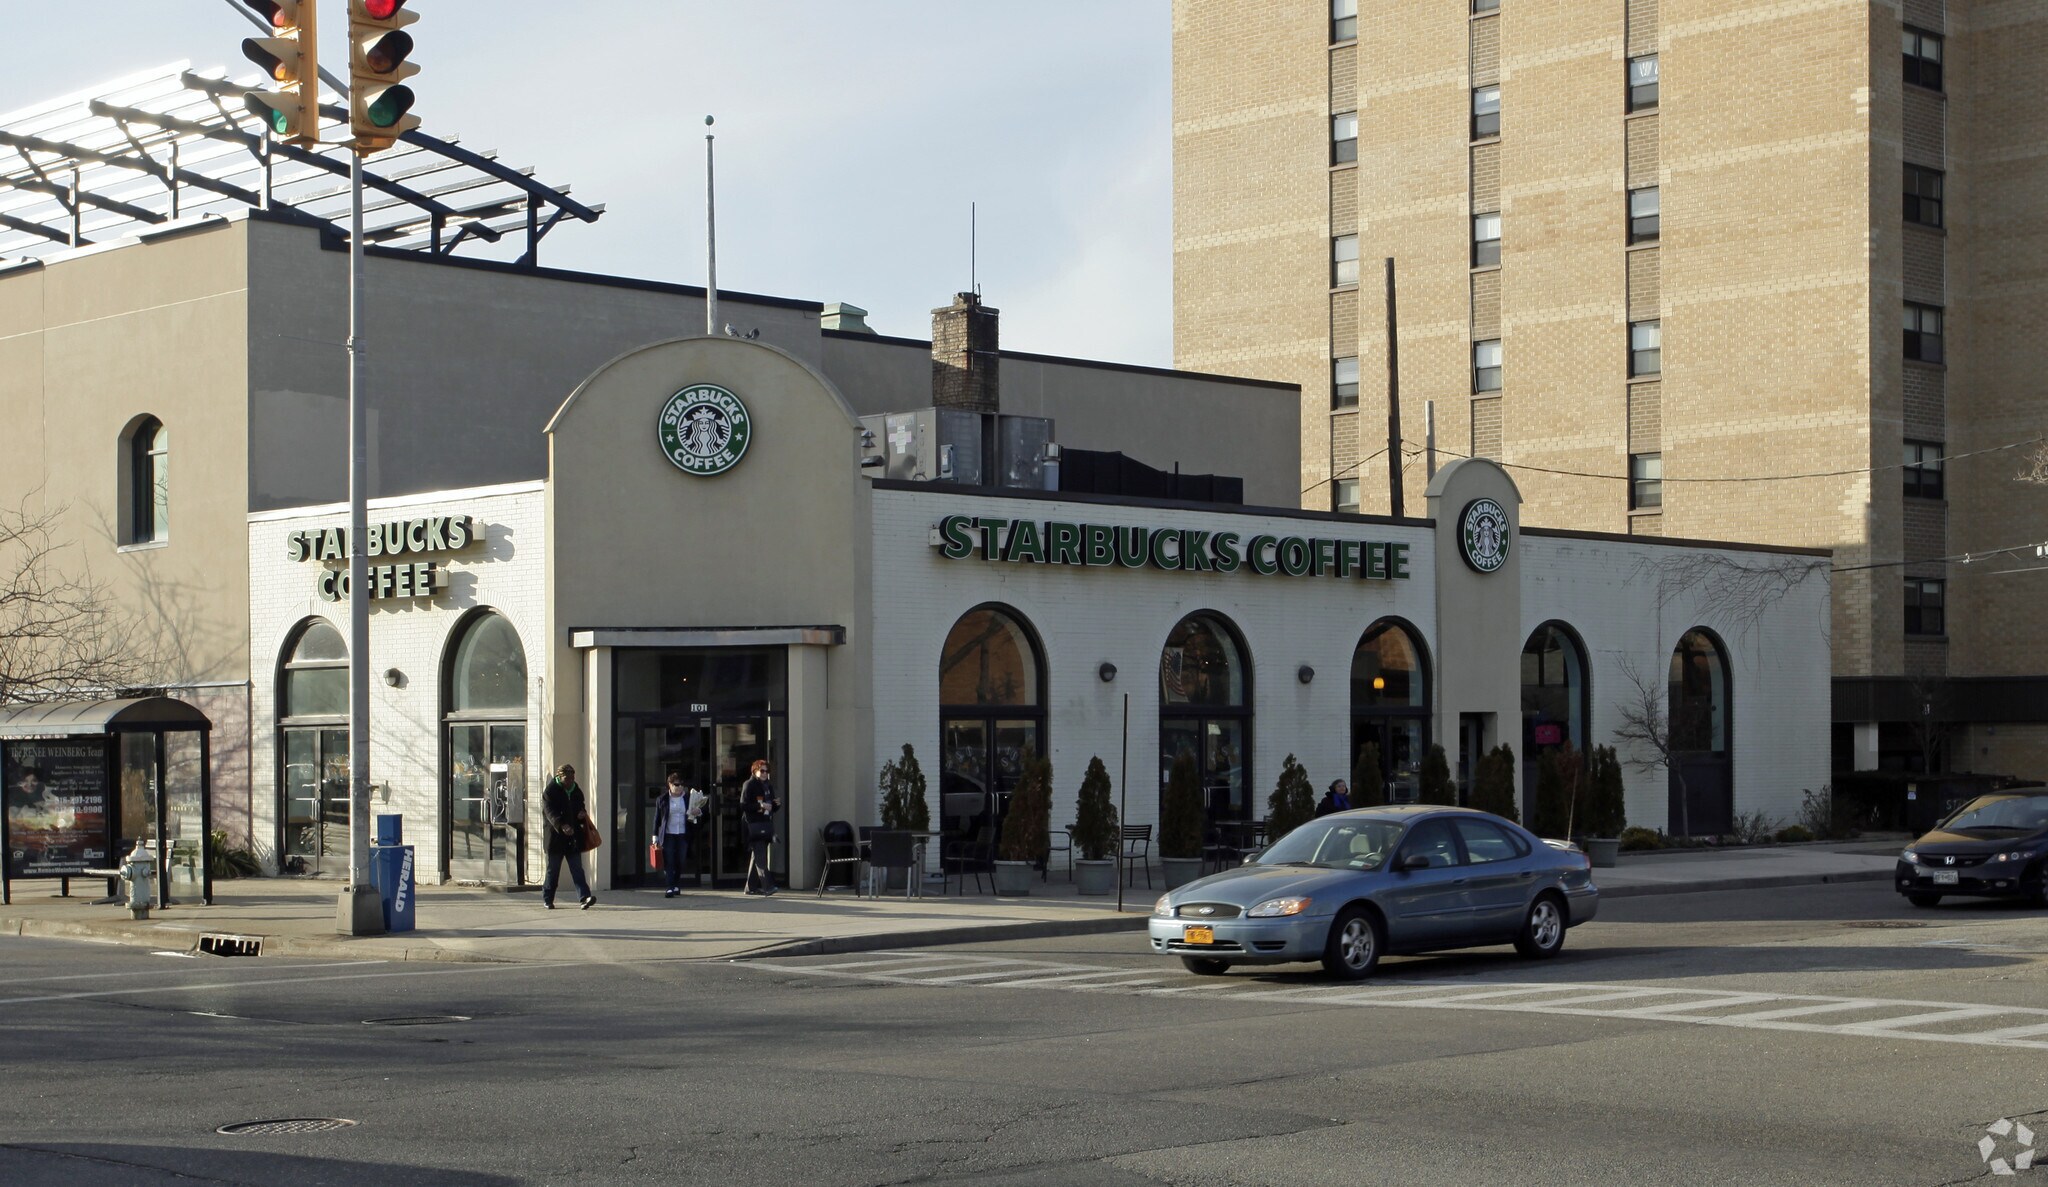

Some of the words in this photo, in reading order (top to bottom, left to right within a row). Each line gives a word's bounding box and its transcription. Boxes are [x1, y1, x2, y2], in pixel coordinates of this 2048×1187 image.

[664, 389, 744, 426] STARBUCKS
[673, 448, 735, 470] COFFEE
[1467, 502, 1507, 532] STARBUCKS
[942, 515, 1241, 573] STARBUCKS
[1250, 534, 1411, 580] COFFEE
[1471, 550, 1503, 568] COFFEE
[692, 704, 706, 712] 101
[11, 747, 22, 757] The
[23, 747, 47, 758] RENEE
[47, 747, 86, 758] WEINBERG
[87, 747, 104, 757] Team
[396, 849, 413, 912] HERALD
